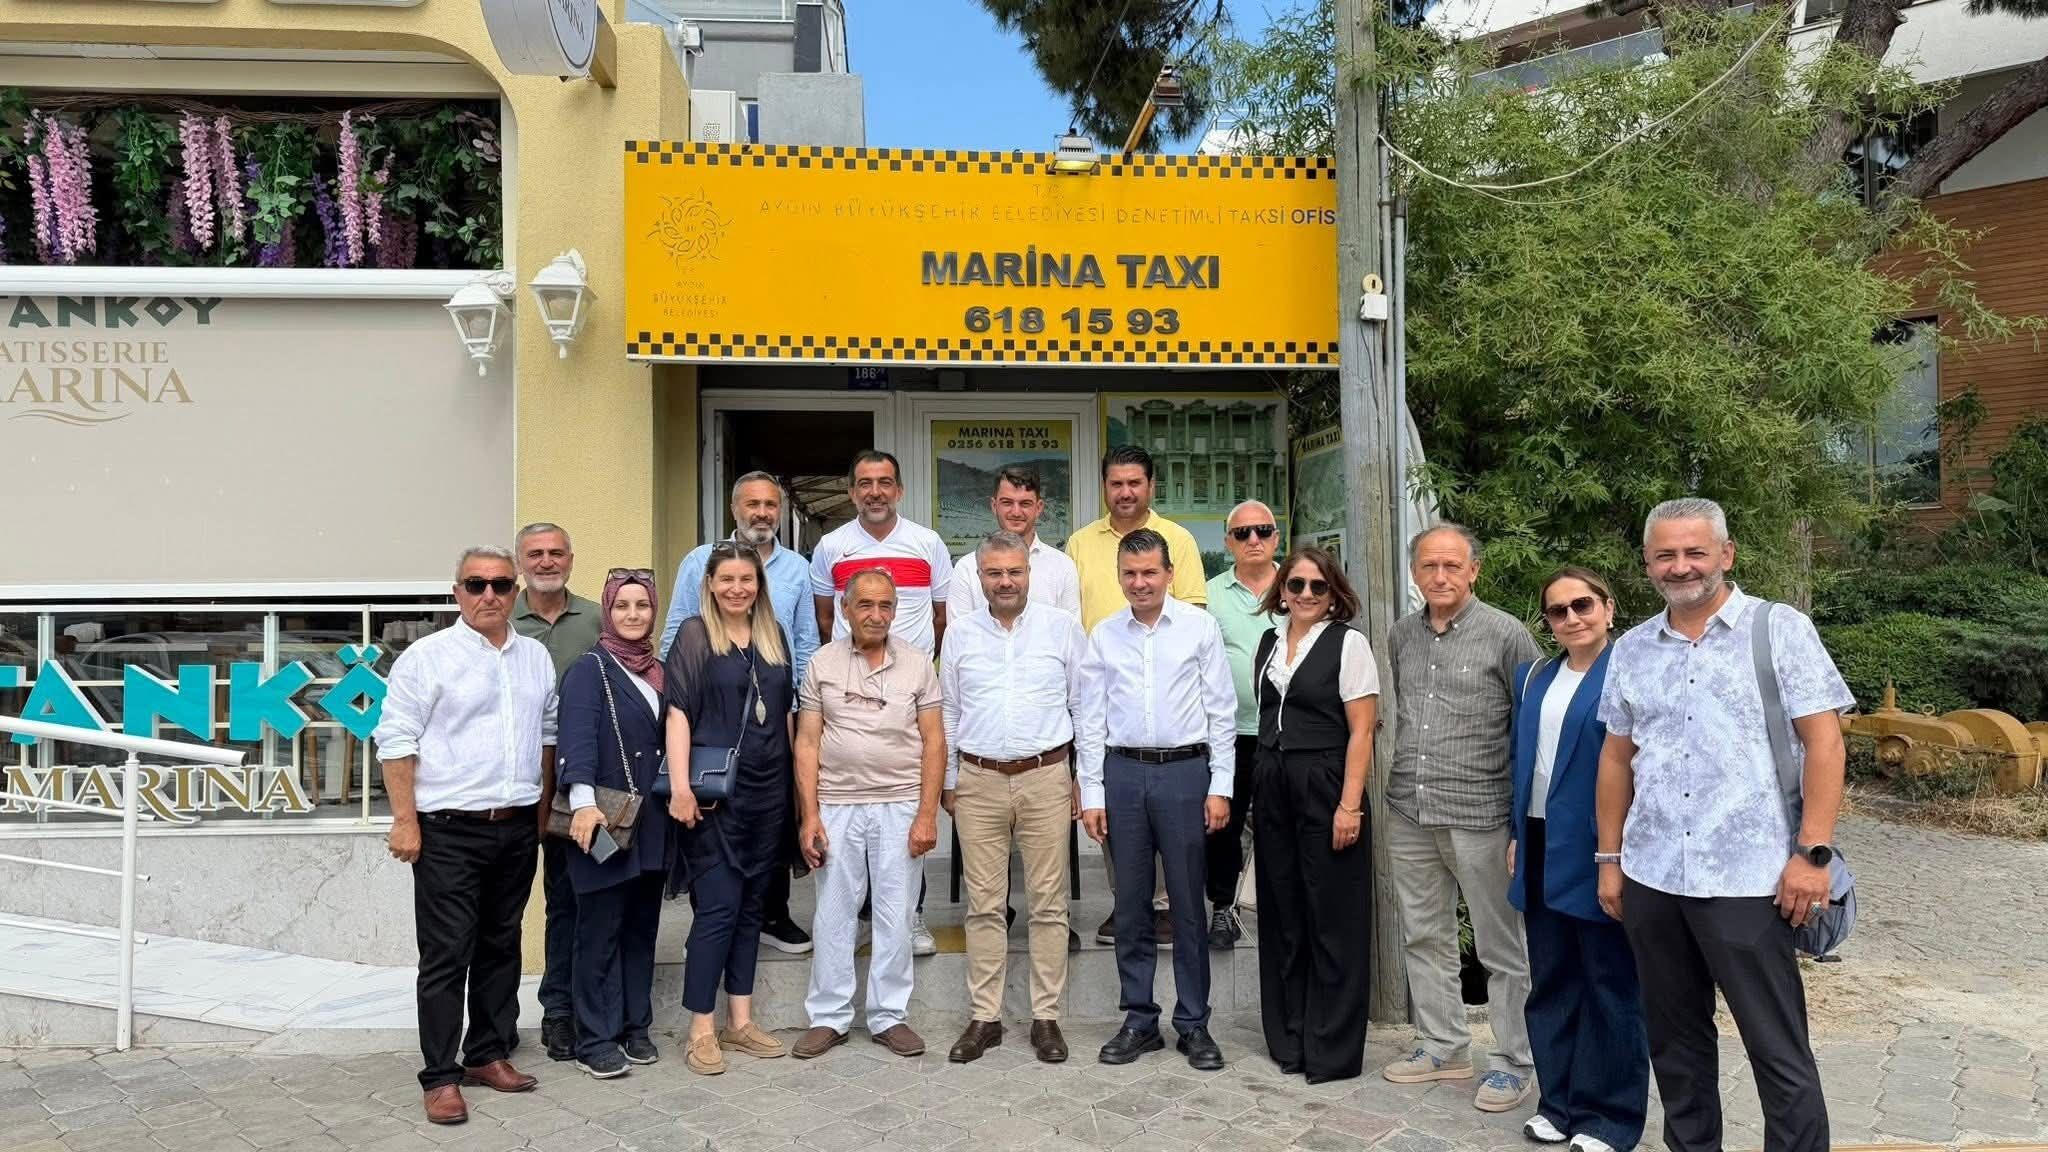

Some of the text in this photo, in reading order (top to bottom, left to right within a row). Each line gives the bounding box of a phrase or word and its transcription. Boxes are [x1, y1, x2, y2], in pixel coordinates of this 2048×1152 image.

[1228, 206, 1285, 225] TAKSİ
[921, 244, 1220, 289] MARİNA TAXI
[0, 296, 222, 328] ANKOY
[964, 305, 1180, 335] 618 15 93
[0, 367, 194, 413] ARINA
[947, 440, 1058, 448] 0256 618 15 93
[958, 427, 1049, 438] MARINA TAXI
[0, 644, 388, 744] ANKÖ
[2, 765, 316, 825] MARINA
